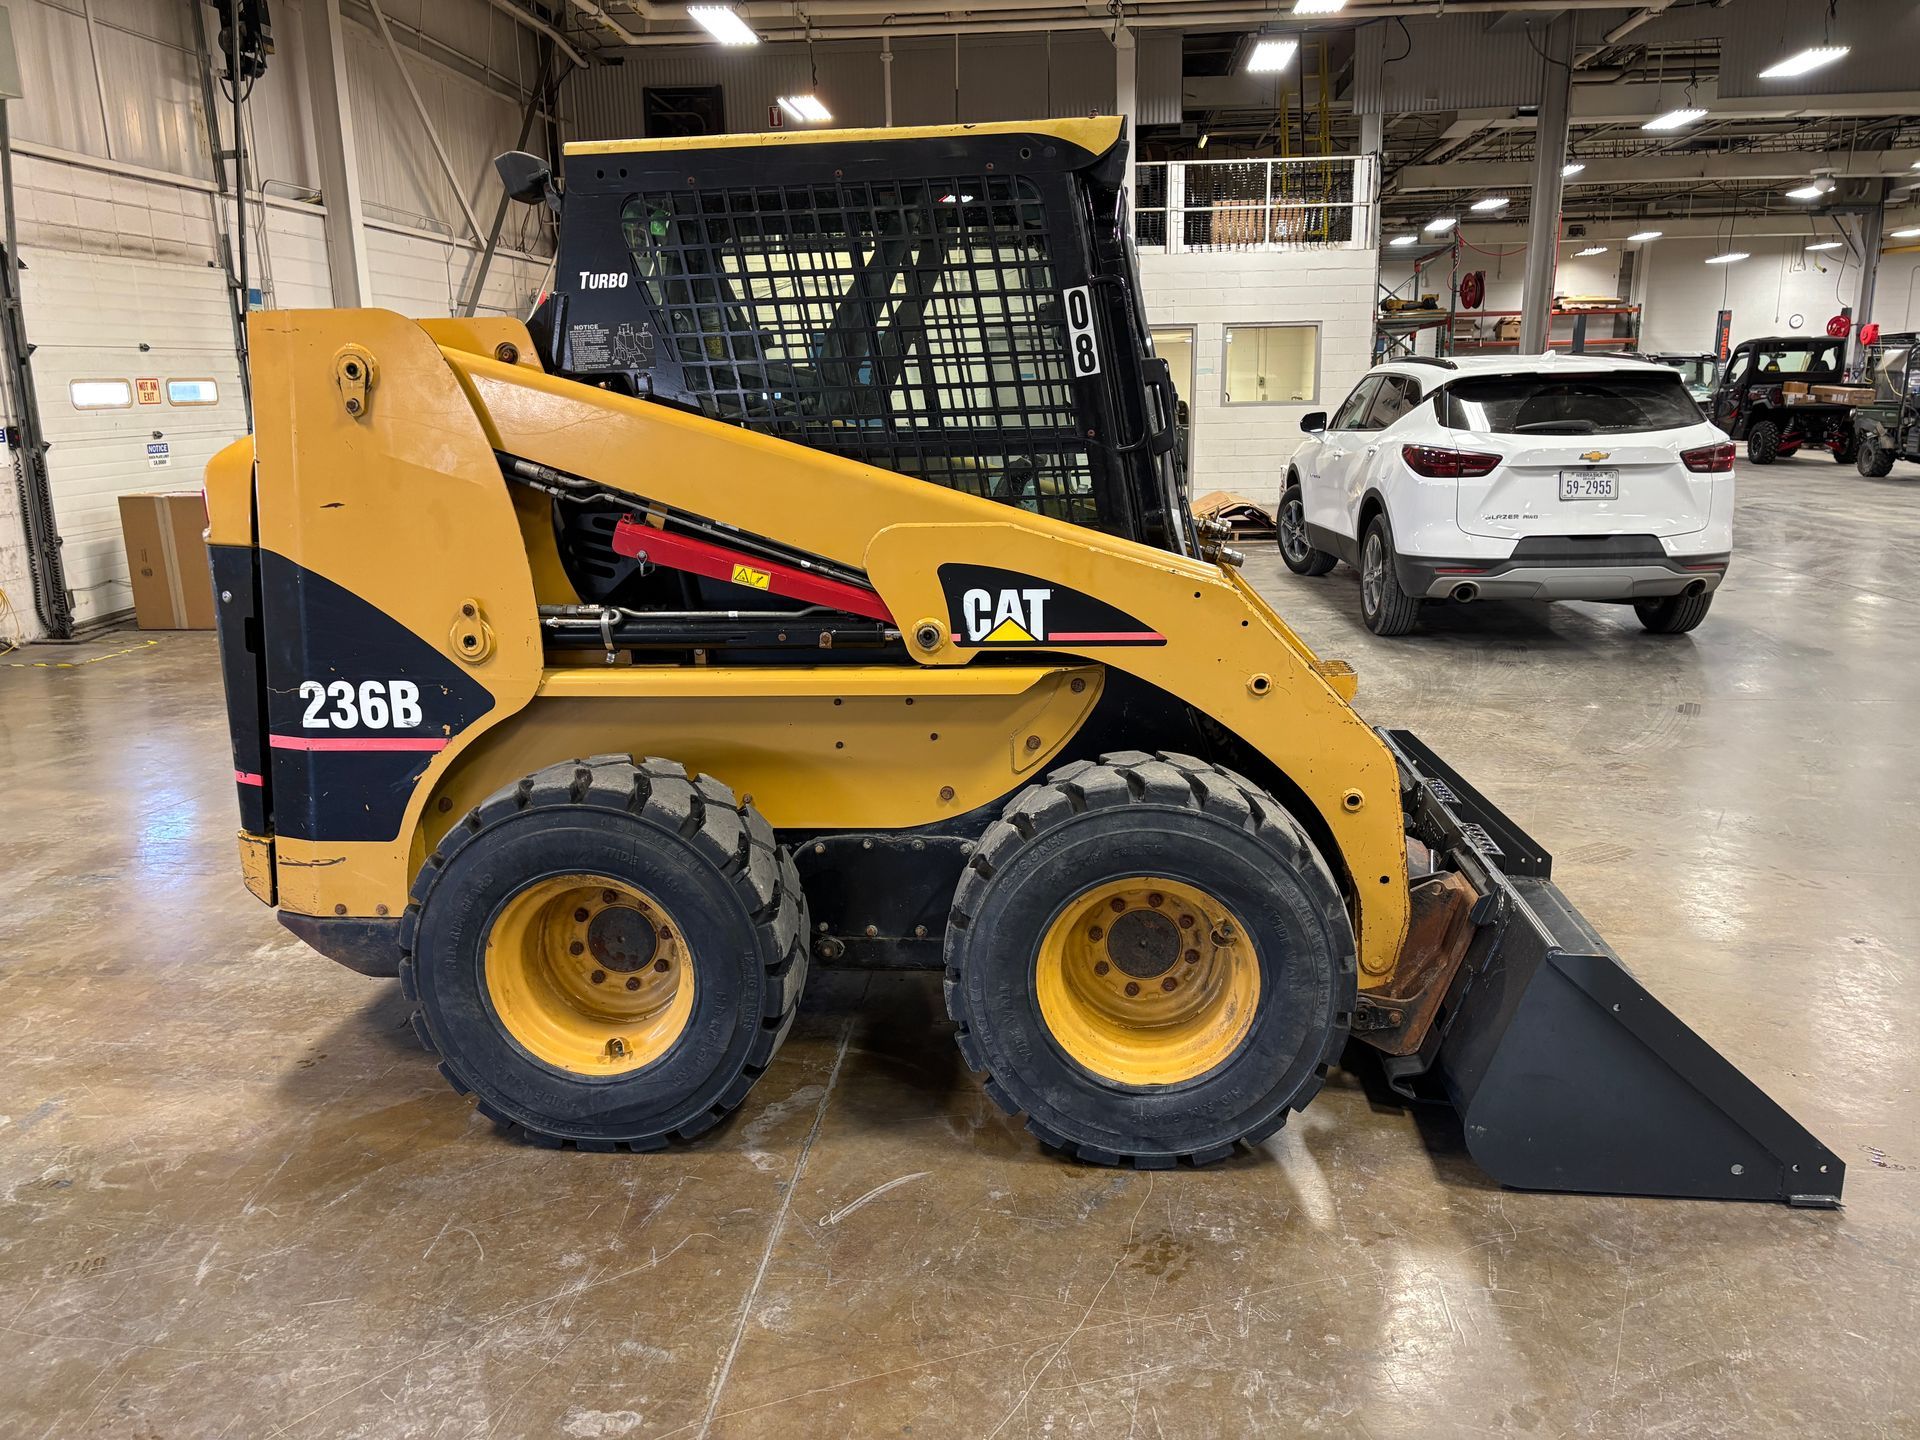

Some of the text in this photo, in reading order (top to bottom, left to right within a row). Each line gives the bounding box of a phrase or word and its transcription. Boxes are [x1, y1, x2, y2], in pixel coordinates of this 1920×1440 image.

[579, 271, 628, 290] TURBO
[1720, 327, 1729, 361] STRATUS
[138, 381, 158, 391] NOT AN
[144, 392, 155, 402] EXIT
[148, 444, 168, 453] NOTICE
[1566, 480, 1612, 495] 59-2955
[963, 588, 1051, 642] CAT
[299, 680, 423, 730] 236B
